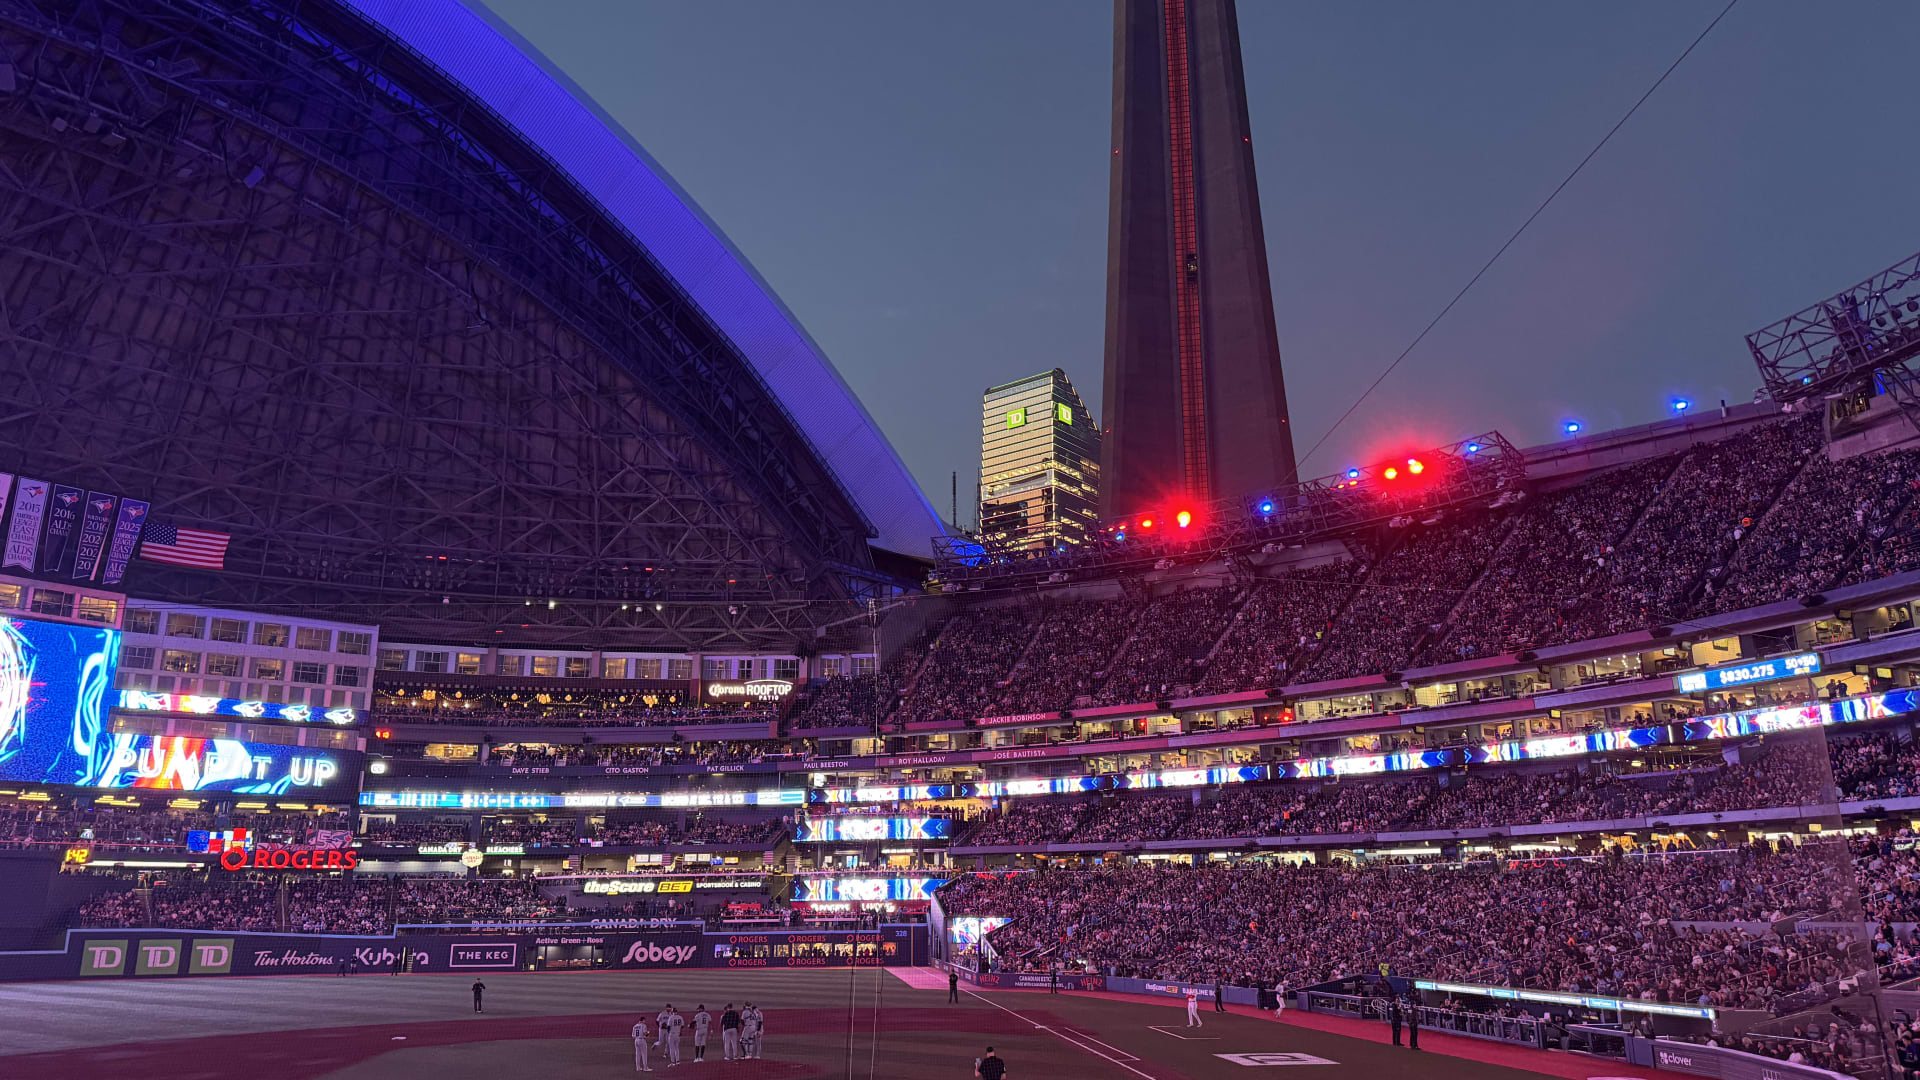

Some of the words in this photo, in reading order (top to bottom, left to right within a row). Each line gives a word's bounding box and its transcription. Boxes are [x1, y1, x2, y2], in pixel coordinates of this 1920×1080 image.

[1009, 412, 1022, 424] TD
[18, 501, 40, 513] 2015
[54, 508, 75, 520] 2016
[119, 521, 141, 532] 2025
[82, 533, 101, 545] 202
[9, 544, 33, 556] ALDS
[80, 546, 98, 558] 202
[709, 684, 745, 697] Corona
[746, 685, 792, 695] ROOFTOP
[989, 716, 1011, 724] JACKIE
[1012, 713, 1046, 723] ROBINSON
[912, 756, 946, 764] HALLADAY
[1013, 750, 1046, 758] BAUTISTA
[820, 761, 849, 769] BEESTON
[291, 756, 336, 787] UP
[254, 849, 357, 869] ROGERS
[584, 881, 655, 894] theScore
[659, 882, 692, 891] BET
[738, 935, 768, 943] ROGERS
[796, 935, 826, 943] ROGERS
[855, 934, 885, 942] ROGERS
[88, 946, 122, 968] TD
[142, 946, 176, 968] TD
[196, 945, 228, 967] TD
[254, 950, 279, 966] Tim
[280, 949, 334, 966] Hortons
[458, 951, 481, 960] THE
[486, 951, 509, 960] KEG
[622, 941, 697, 964] Sobeys
[737, 958, 767, 966] ROGERS
[796, 957, 826, 965] ROGERS
[855, 957, 885, 965] ROGERS
[980, 974, 1000, 984] HEINZ
[1080, 976, 1103, 987] HEINZ
[1668, 1052, 1692, 1066] clover
